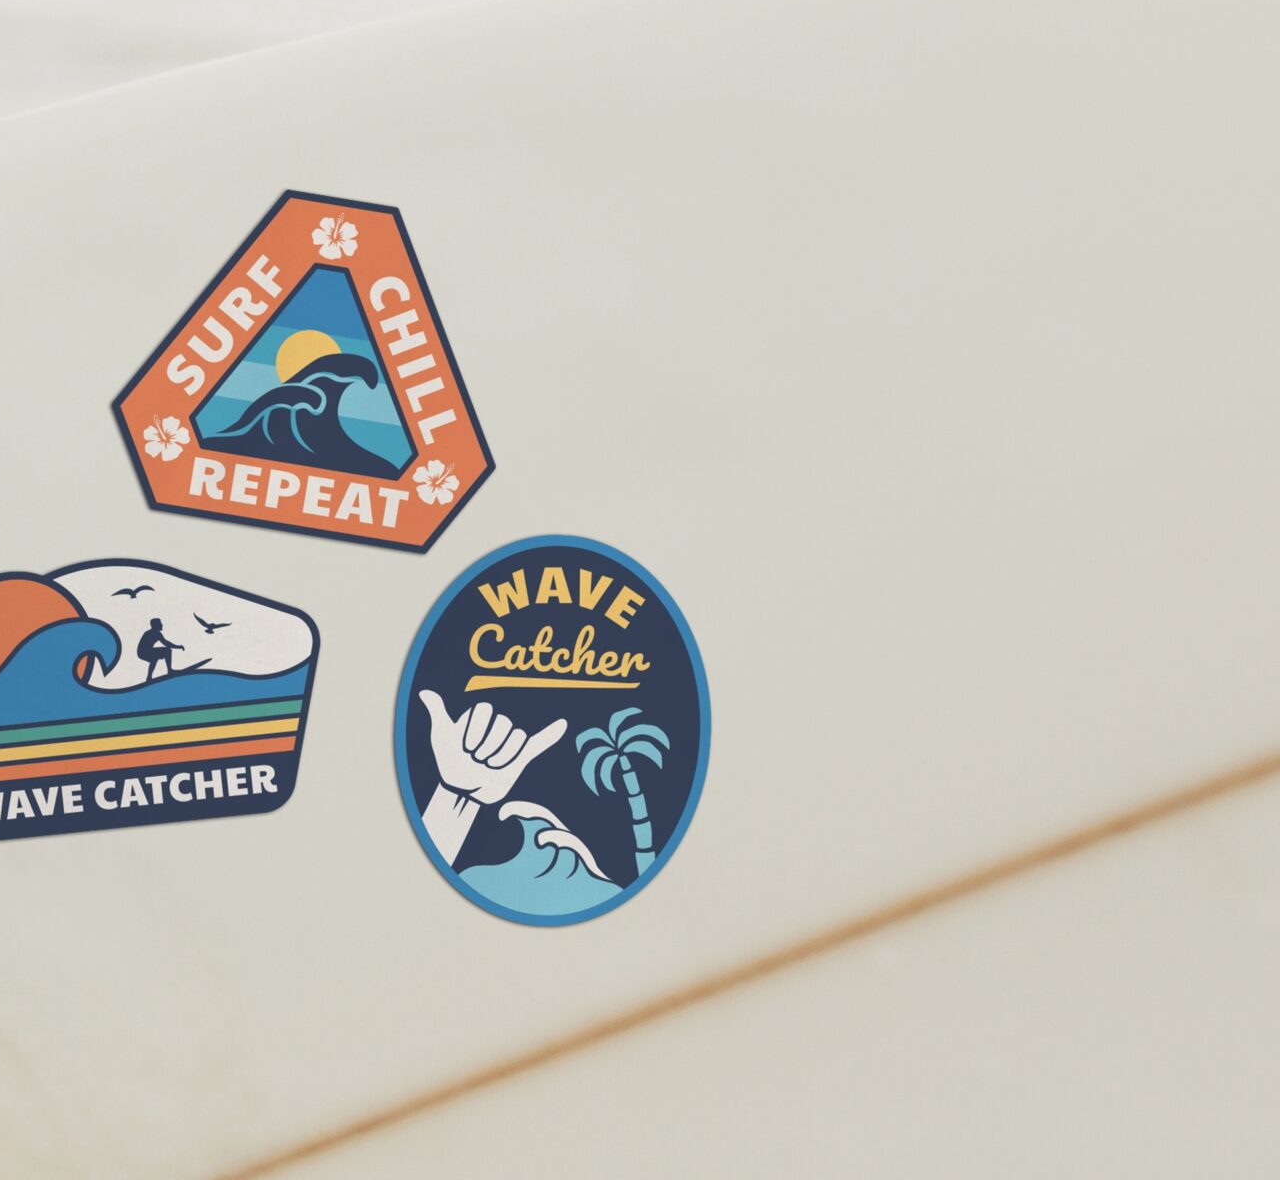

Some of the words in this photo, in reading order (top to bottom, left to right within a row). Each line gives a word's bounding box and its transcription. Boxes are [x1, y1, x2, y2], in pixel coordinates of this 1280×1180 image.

[166, 254, 283, 396] SURF
[369, 276, 457, 446] CHILL
[188, 456, 409, 528] REPEAT
[477, 566, 646, 629] WAVE
[468, 623, 650, 677] Catcher
[94, 764, 278, 810] CATCHER
